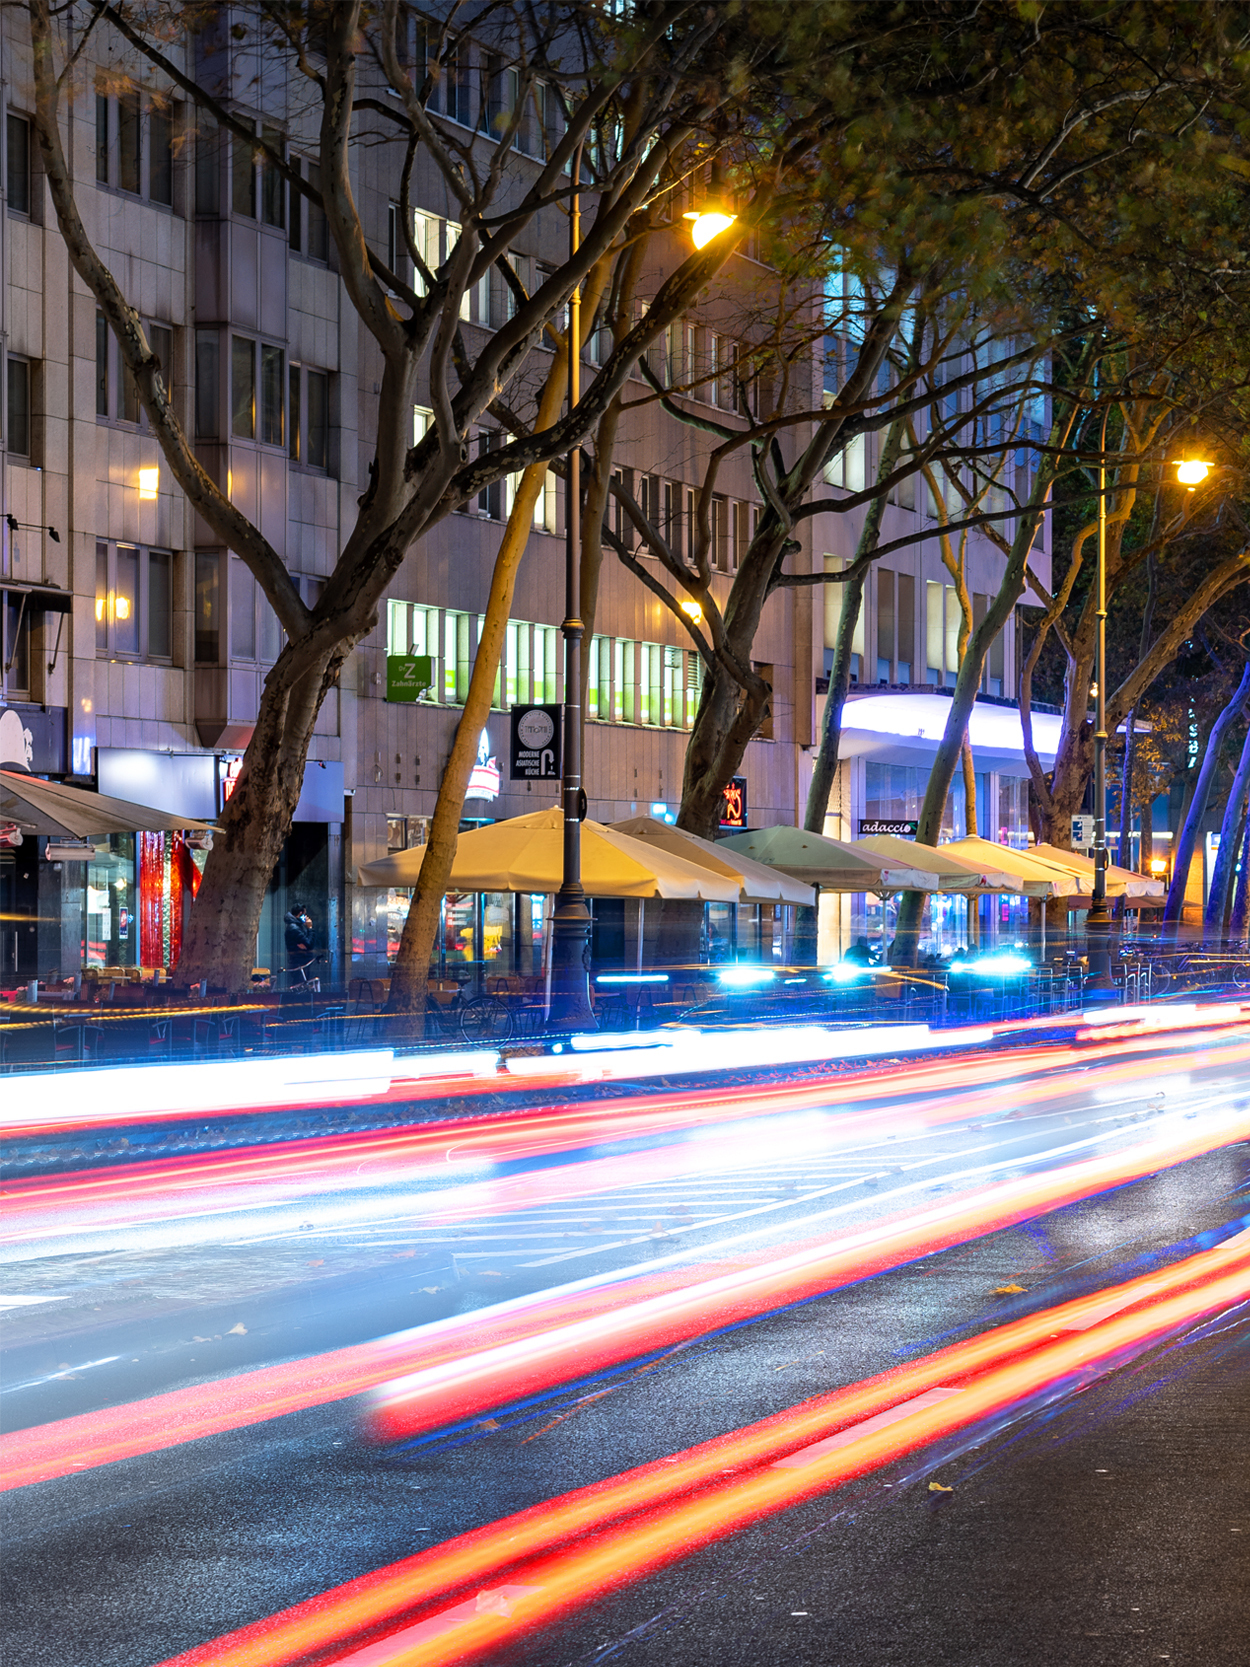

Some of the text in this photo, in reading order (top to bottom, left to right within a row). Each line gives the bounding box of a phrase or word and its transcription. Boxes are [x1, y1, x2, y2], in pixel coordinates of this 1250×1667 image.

[518, 750, 540, 758] MODERNE
[515, 759, 540, 767] ASIATISCHE
[524, 767, 540, 776] KÜCHE
